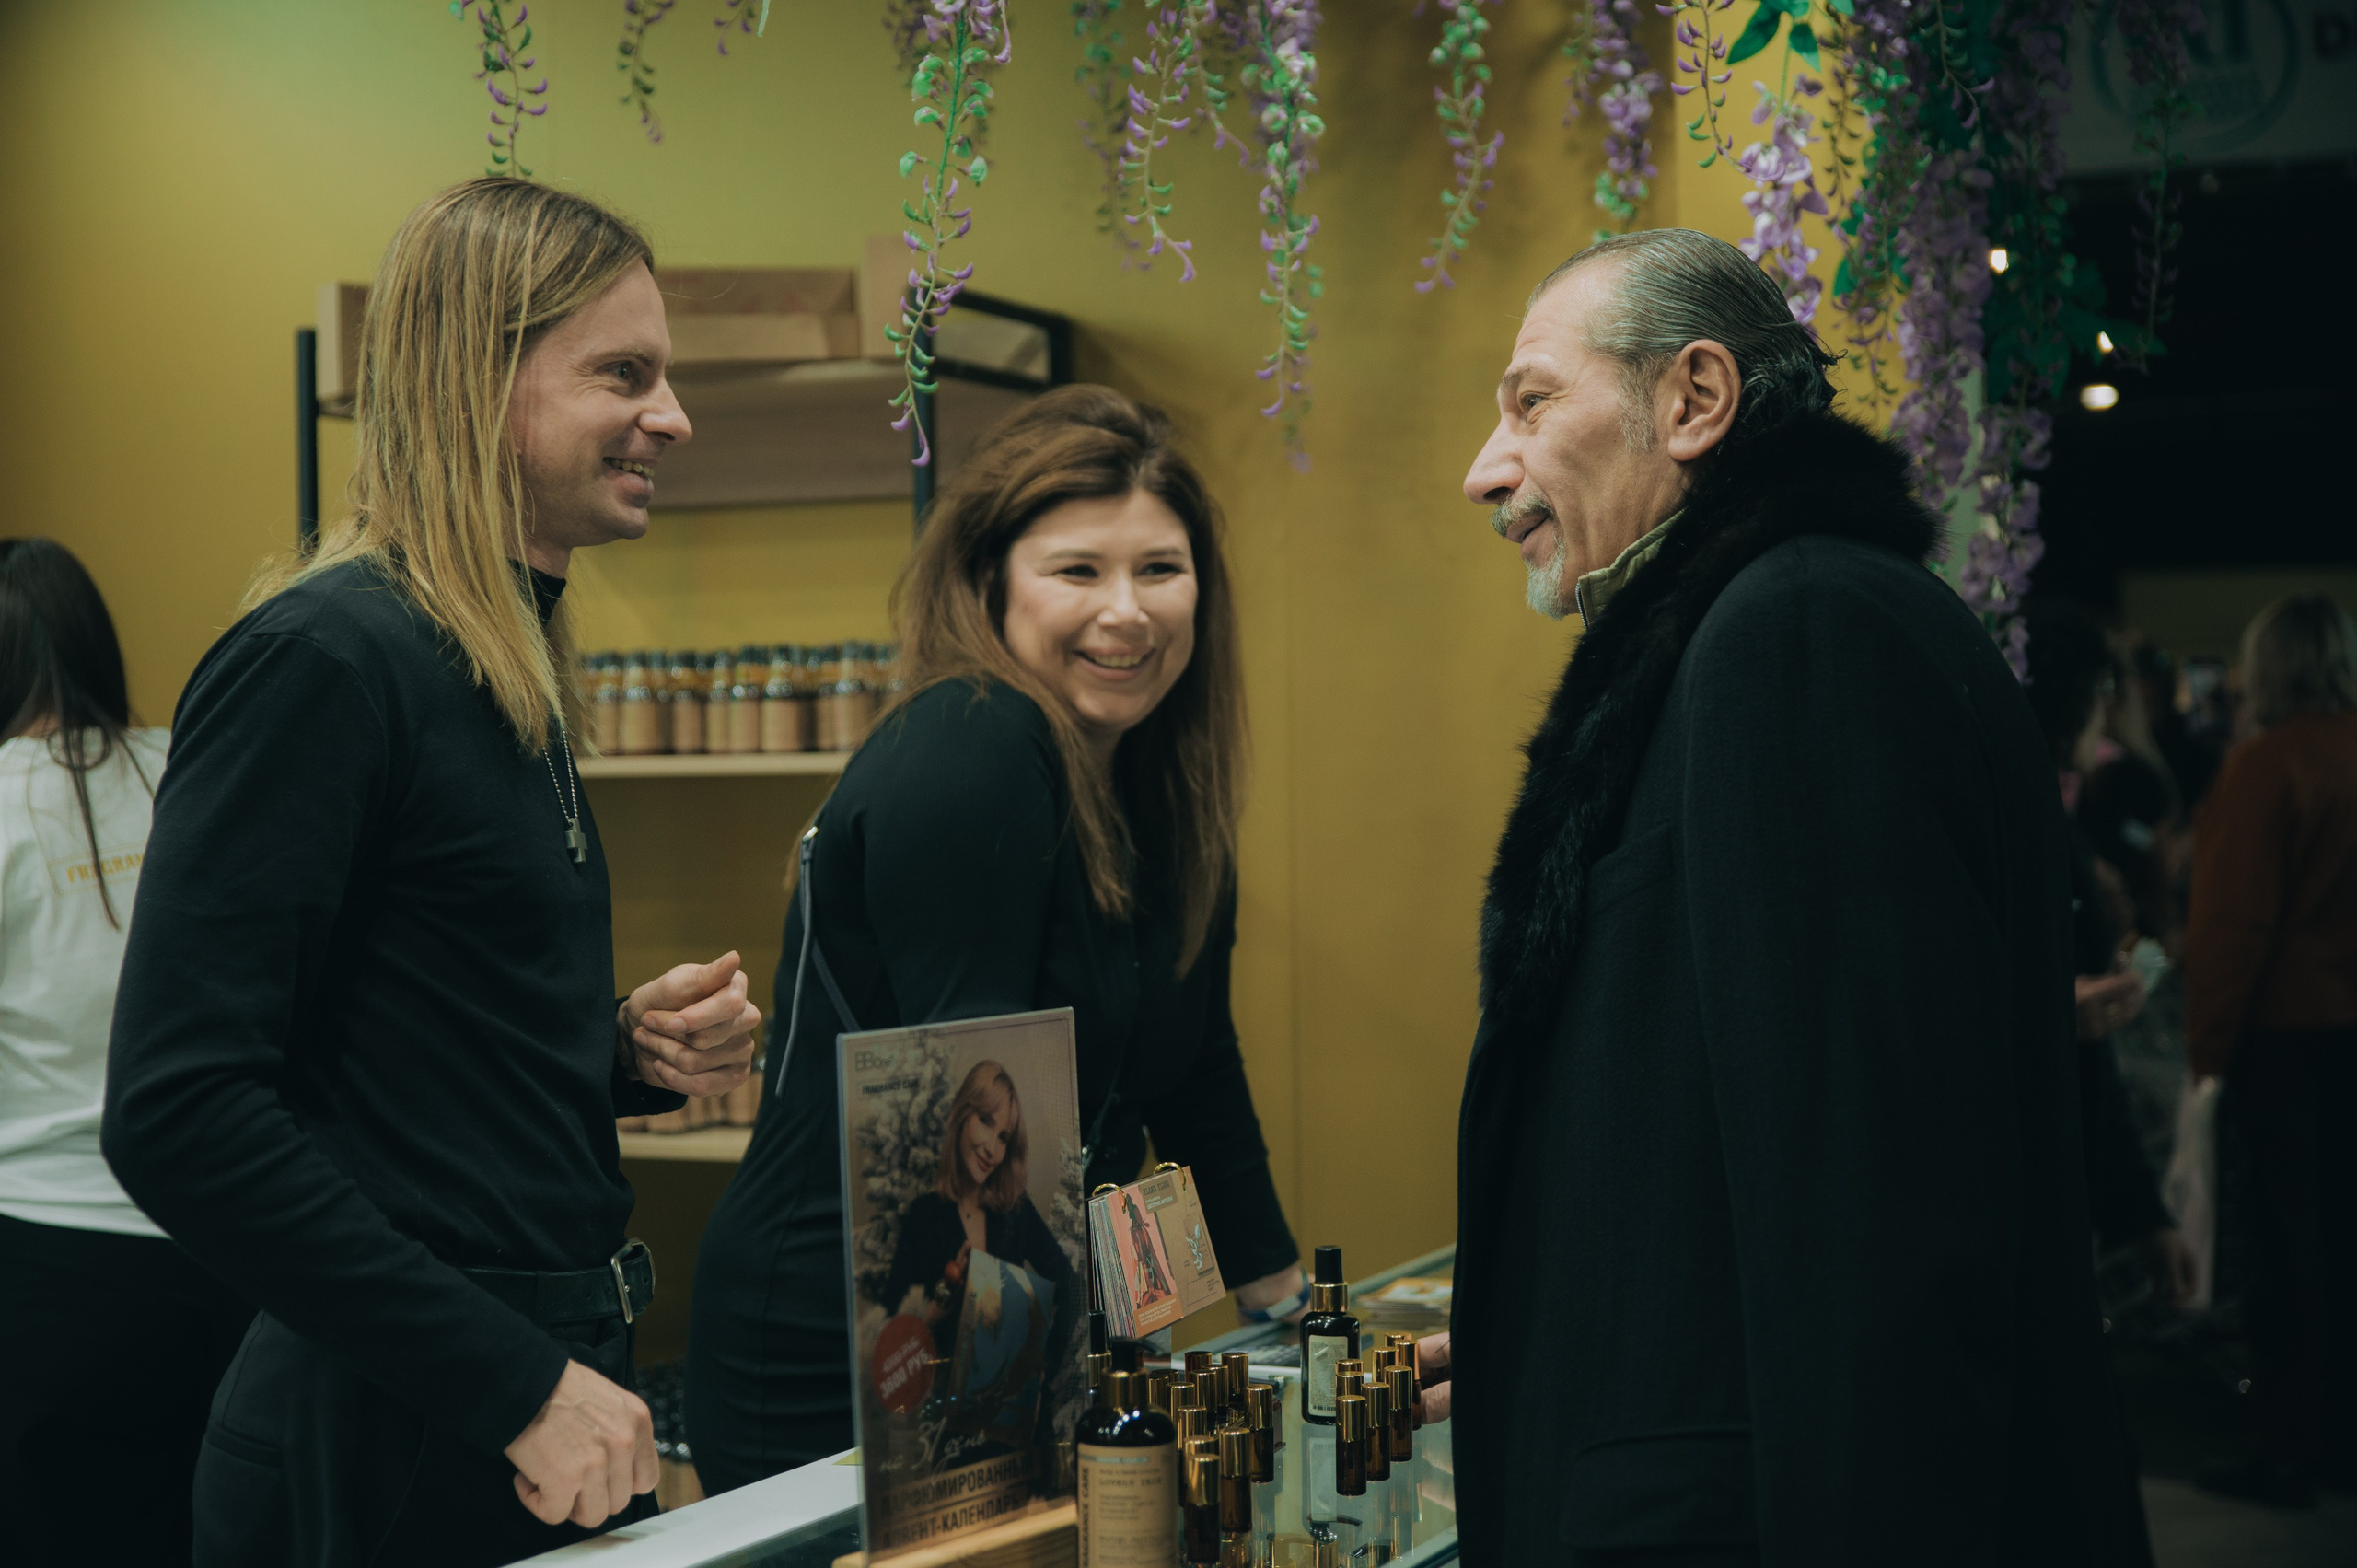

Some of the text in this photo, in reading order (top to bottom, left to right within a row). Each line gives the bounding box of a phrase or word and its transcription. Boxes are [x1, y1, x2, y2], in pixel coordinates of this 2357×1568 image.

[1143, 1180, 1170, 1196] YLANG YLANG
[879, 1365, 907, 1399] 3600
